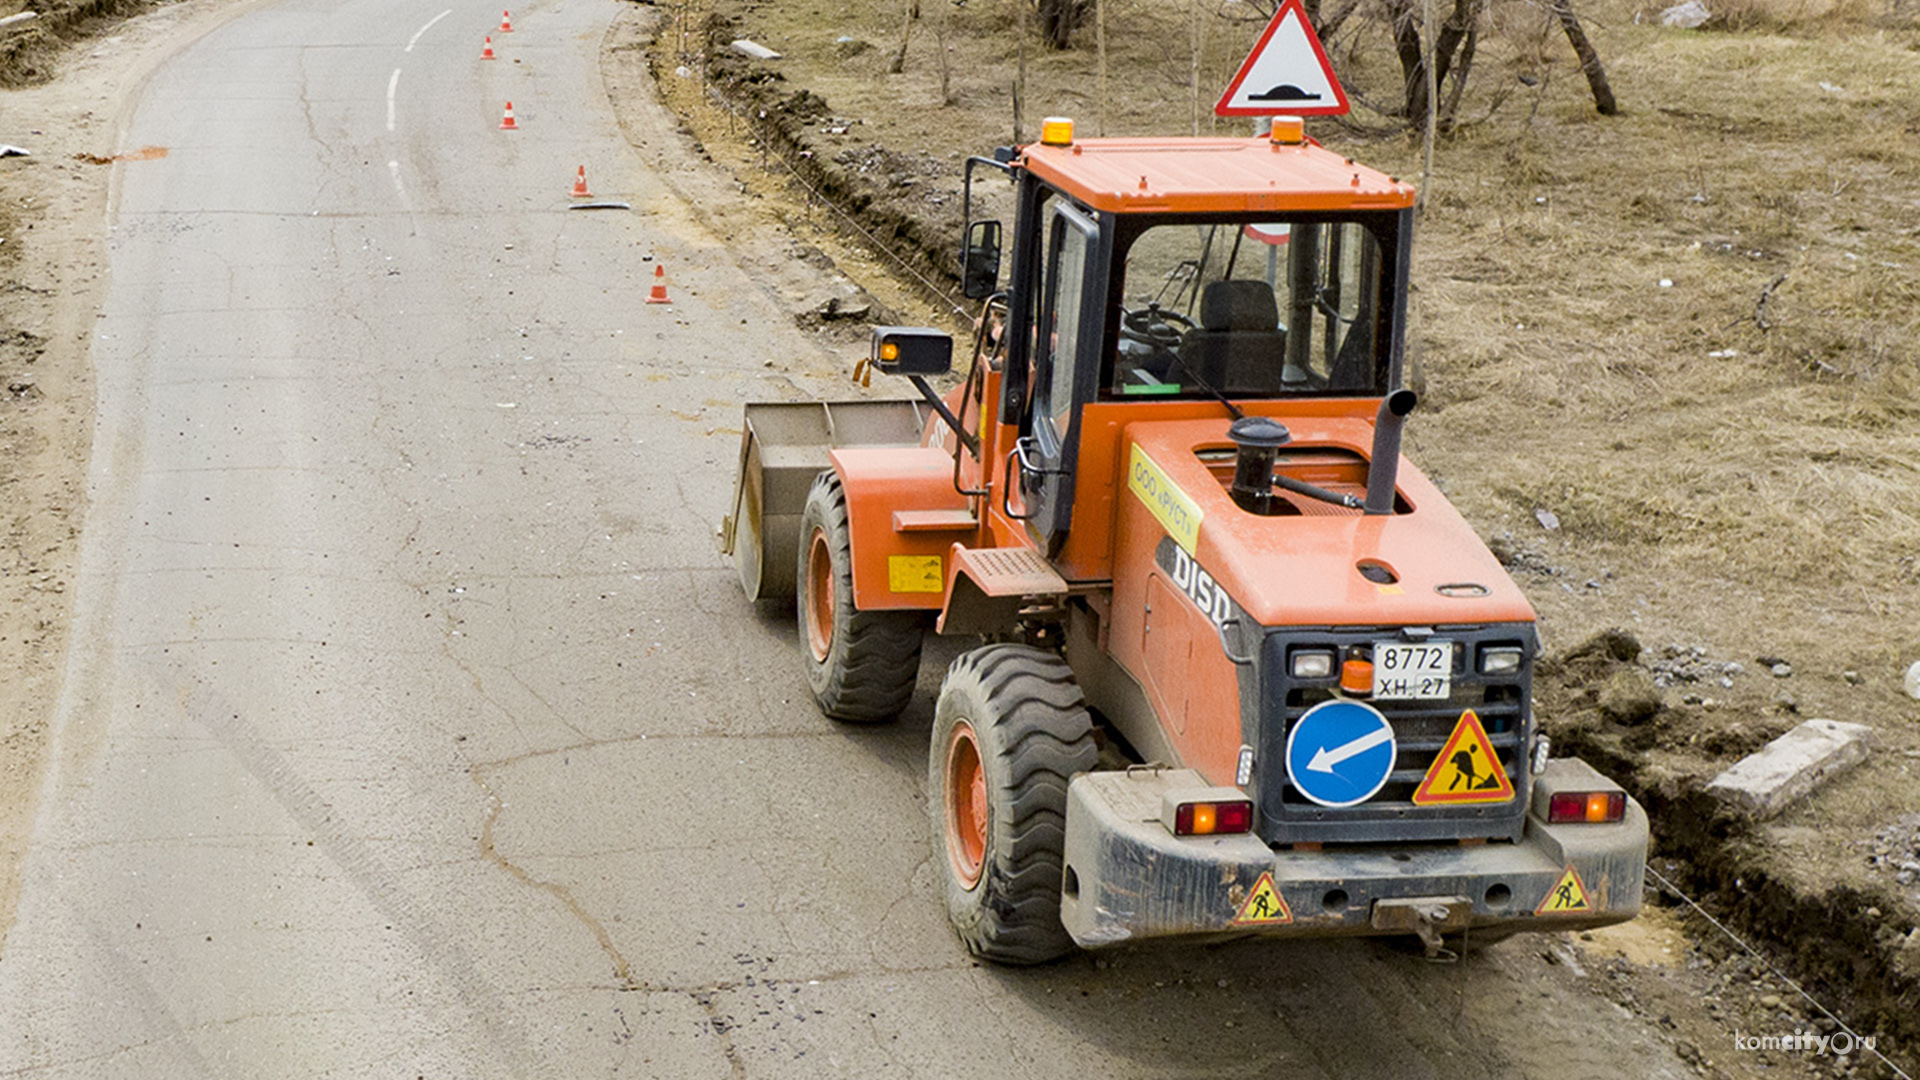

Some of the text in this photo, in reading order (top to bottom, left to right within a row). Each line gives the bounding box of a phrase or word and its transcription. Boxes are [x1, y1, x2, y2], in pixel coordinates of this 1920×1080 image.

[1135, 462, 1156, 496] ООО
[1384, 648, 1443, 670] 8772
[1421, 678, 1444, 696] 27
